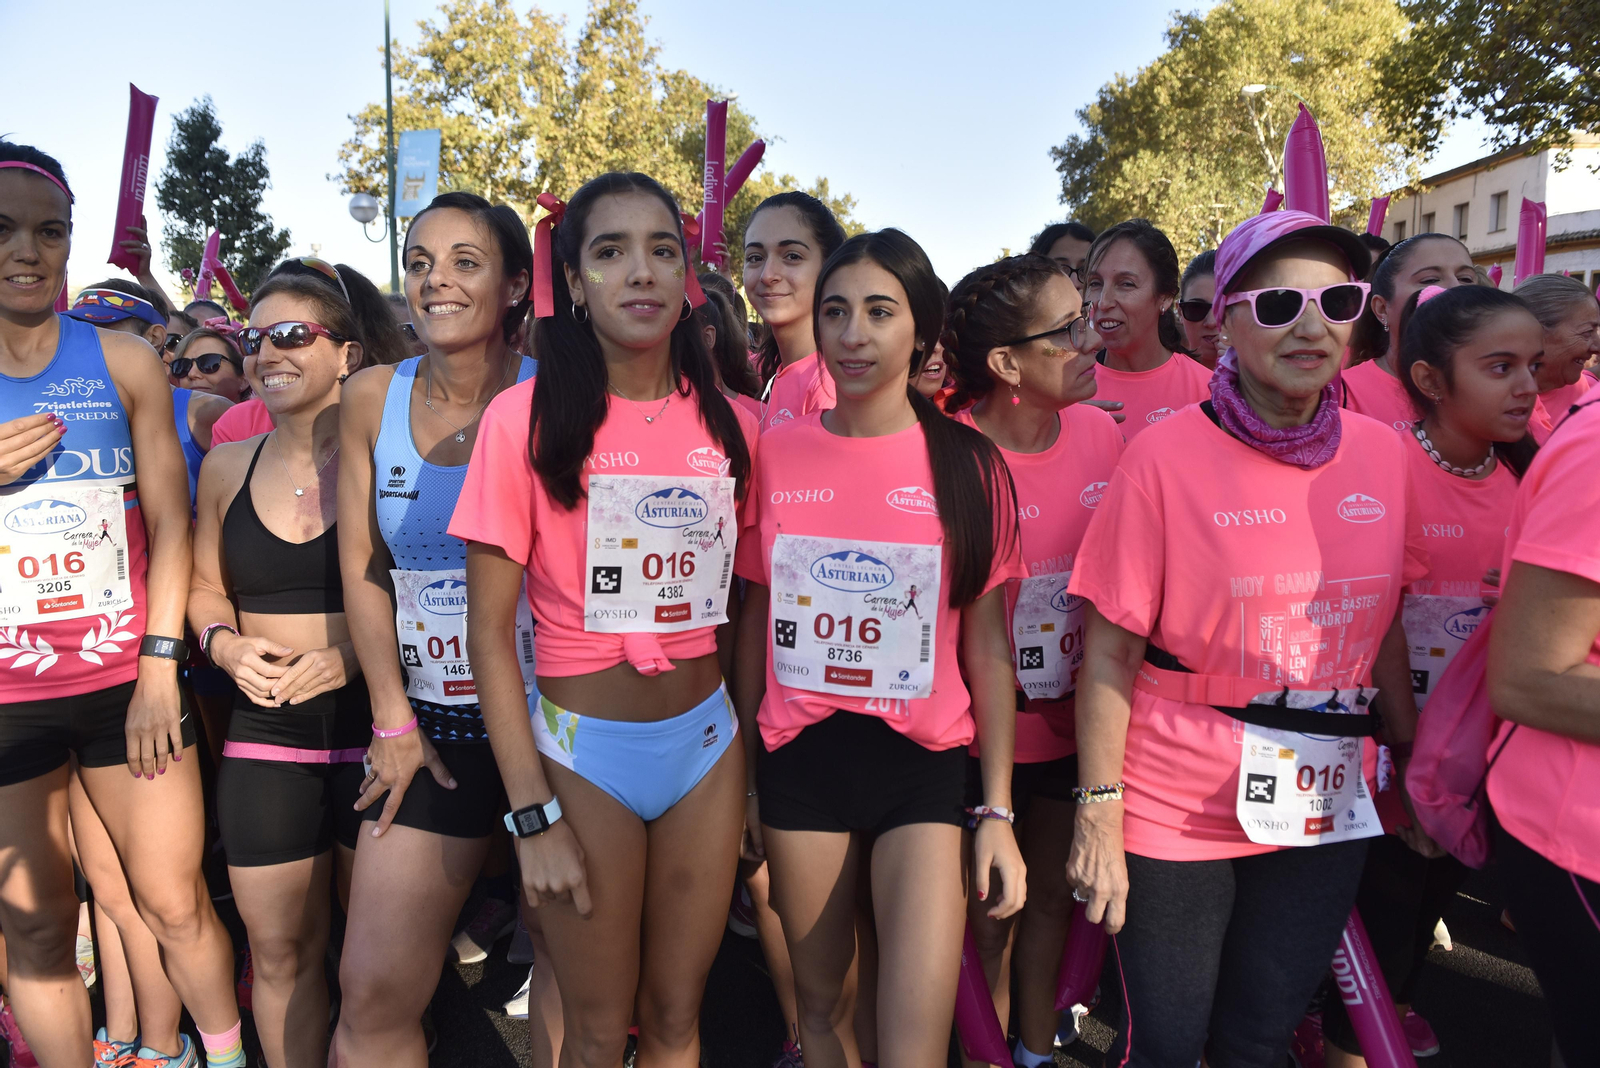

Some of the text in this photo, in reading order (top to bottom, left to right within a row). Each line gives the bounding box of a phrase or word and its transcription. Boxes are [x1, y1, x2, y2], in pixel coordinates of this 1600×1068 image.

[704, 160, 719, 203] Ladival
[33, 400, 112, 413] Triatletines
[64, 411, 118, 421] CREDUS
[583, 451, 639, 469] YSHO
[770, 488, 834, 505] OYSHO
[641, 502, 703, 518] ASTURIANA
[1214, 507, 1286, 527] OYSHO
[63, 531, 94, 541] Carrera
[682, 527, 710, 538] Carrera
[1421, 523, 1464, 538] YSHO
[18, 551, 85, 579] 016
[642, 551, 696, 580] 016
[1031, 553, 1073, 577] GANAN
[816, 563, 887, 584] ASTURIANA
[37, 580, 72, 594] 3205
[1230, 576, 1265, 597] HOY
[1274, 571, 1325, 595] GANAN
[657, 585, 684, 599] 4382
[864, 593, 898, 605] Carrera
[50, 599, 78, 608] Santander
[98, 598, 121, 607] ZURICH
[424, 593, 467, 606] ASTURIA
[1290, 601, 1331, 616] VITORIA
[1342, 594, 1380, 611] GASTEIZ
[593, 609, 638, 619] OYSHO
[701, 611, 719, 619] ZURICH
[883, 606, 906, 620] Mujer
[1312, 611, 1354, 628] MADRID
[813, 612, 882, 644] 016
[1261, 616, 1273, 629] SE
[1060, 624, 1083, 655] 01
[427, 635, 462, 660] 01
[827, 647, 863, 662] 8736
[1290, 644, 1301, 656] VA
[777, 661, 809, 676] OYSHO
[1289, 657, 1307, 670] LEN
[837, 672, 867, 681] Santander
[1288, 670, 1305, 683] CIA
[1312, 662, 1334, 680] LAS
[414, 677, 435, 691] OYSHO
[889, 683, 918, 691] ZURICH
[1023, 680, 1060, 690] OYSHO
[1296, 764, 1346, 792] 016
[1309, 797, 1334, 811] 1002
[1247, 819, 1290, 831] OYSHO
[1344, 822, 1368, 831] ZURICH
